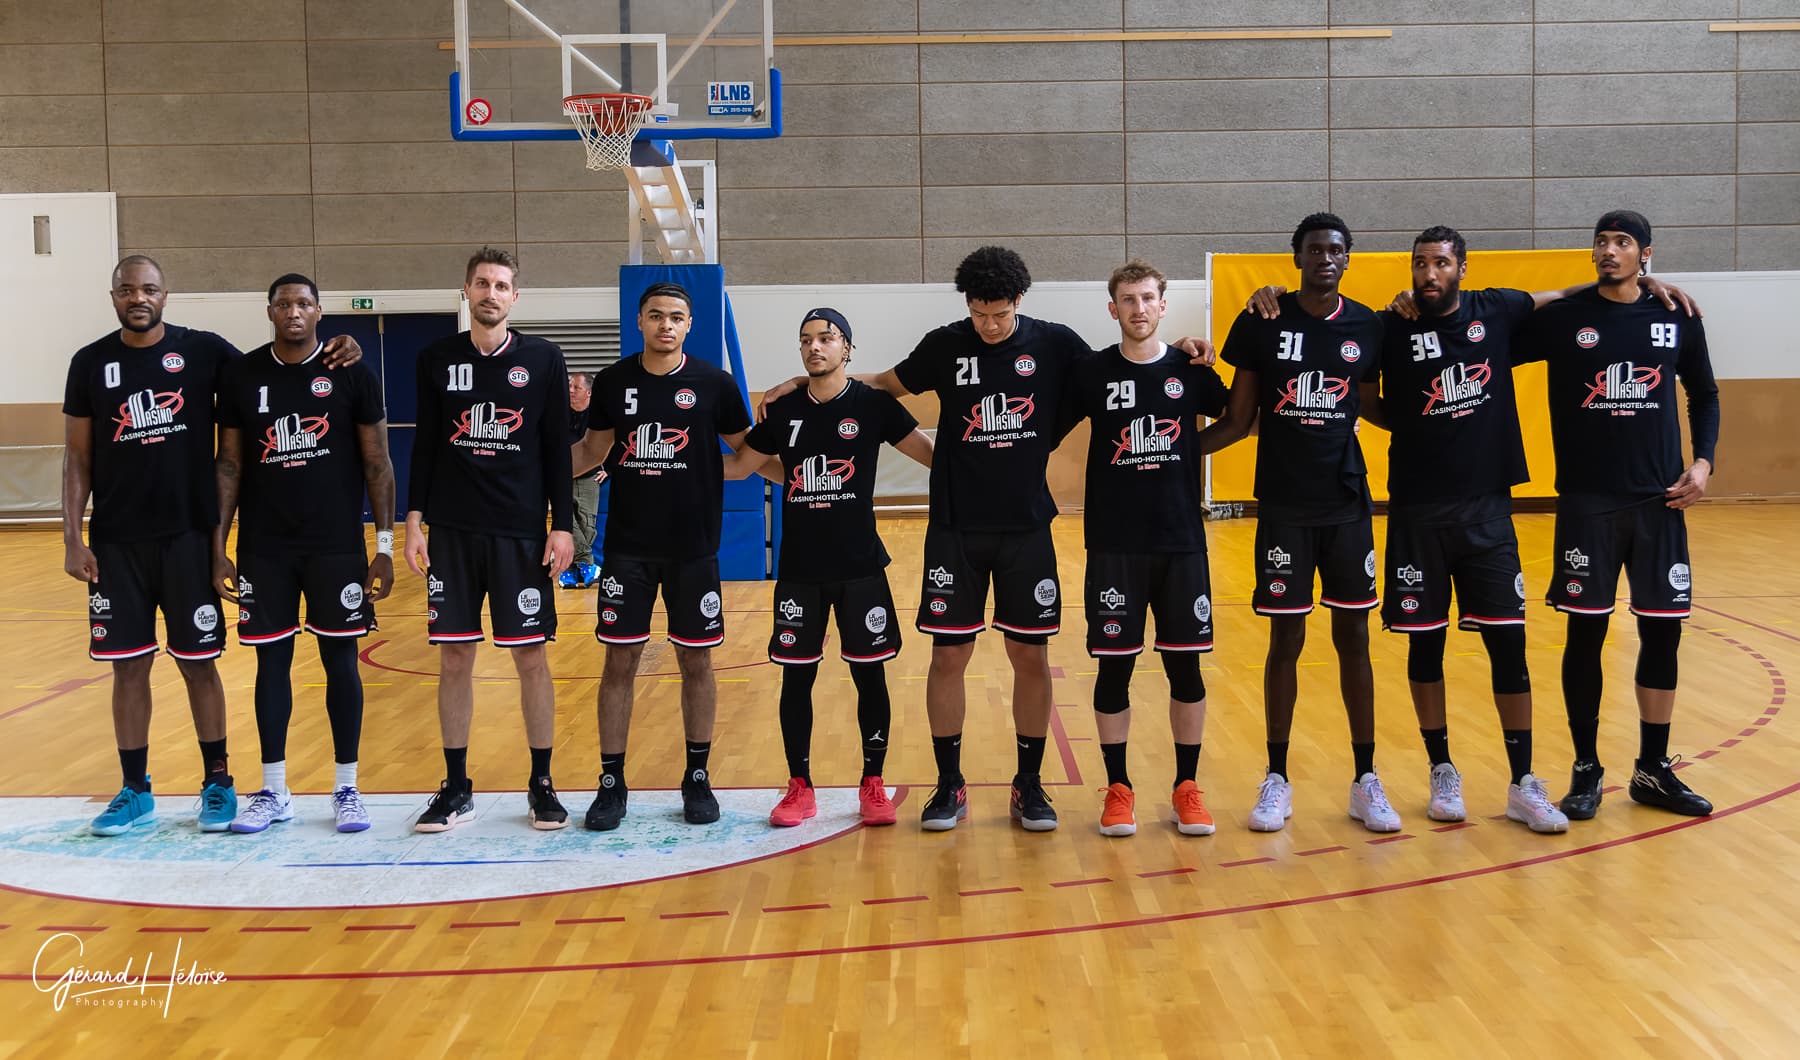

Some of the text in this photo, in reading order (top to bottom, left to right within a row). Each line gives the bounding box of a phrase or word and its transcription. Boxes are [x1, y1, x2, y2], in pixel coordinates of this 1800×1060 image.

[720, 84, 750, 100] LNB
[1469, 327, 1481, 336] STB
[1651, 323, 1677, 348] 93
[1580, 333, 1595, 342] STB
[1277, 331, 1303, 362] 31
[1411, 331, 1442, 361] 39
[1344, 347, 1357, 355] STB
[166, 358, 181, 366] STB
[1018, 361, 1032, 369] STB
[105, 362, 120, 388] 0
[956, 357, 980, 386] 21
[447, 363, 473, 391] 10
[512, 372, 526, 381] STB
[314, 383, 329, 391] STB
[1167, 384, 1180, 392] STB
[258, 386, 269, 413] 1
[678, 394, 693, 402] STB
[1107, 380, 1136, 410] 29
[625, 388, 638, 414] 5
[842, 424, 856, 432] STB
[789, 420, 803, 447] 7
[1568, 584, 1580, 592] STB
[931, 602, 945, 611] STB
[1403, 600, 1417, 608] STB
[604, 612, 615, 620] STB
[93, 628, 106, 636] STB
[1106, 624, 1119, 633] STB
